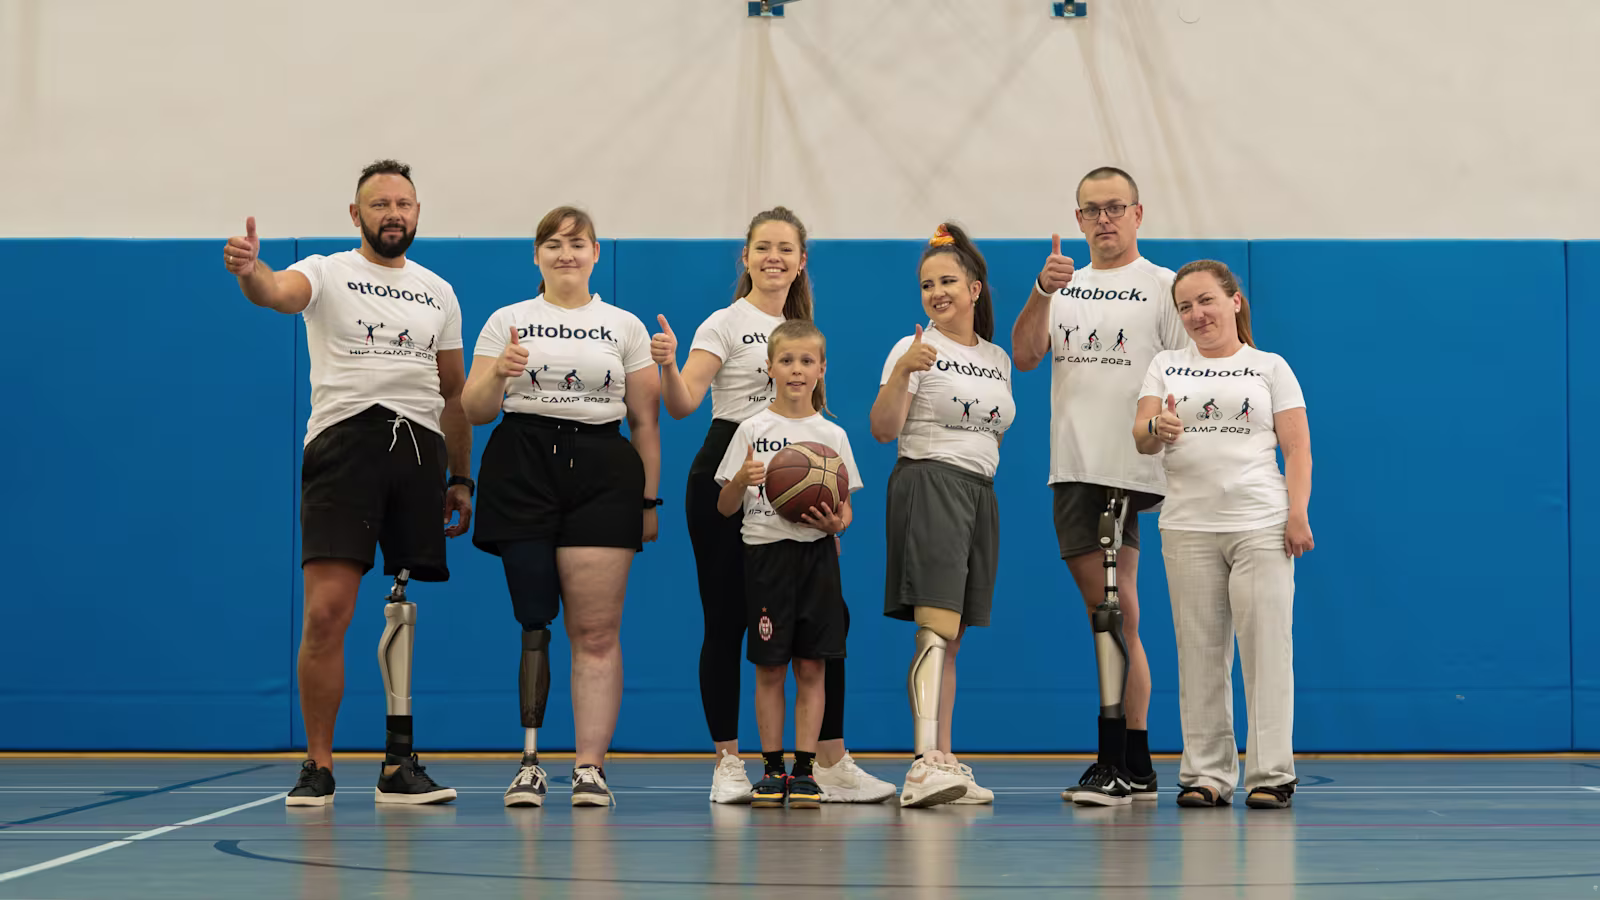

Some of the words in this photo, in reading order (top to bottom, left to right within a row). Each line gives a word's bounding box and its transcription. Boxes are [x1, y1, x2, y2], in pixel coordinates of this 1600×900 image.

[347, 281, 441, 310] ottobock.
[1060, 286, 1147, 302] ottobock.
[1067, 356, 1098, 364] CAMP
[1100, 357, 1132, 366] 2023
[1165, 366, 1261, 378] ottobock.
[583, 396, 611, 404] 2023
[1220, 426, 1251, 435] 2023
